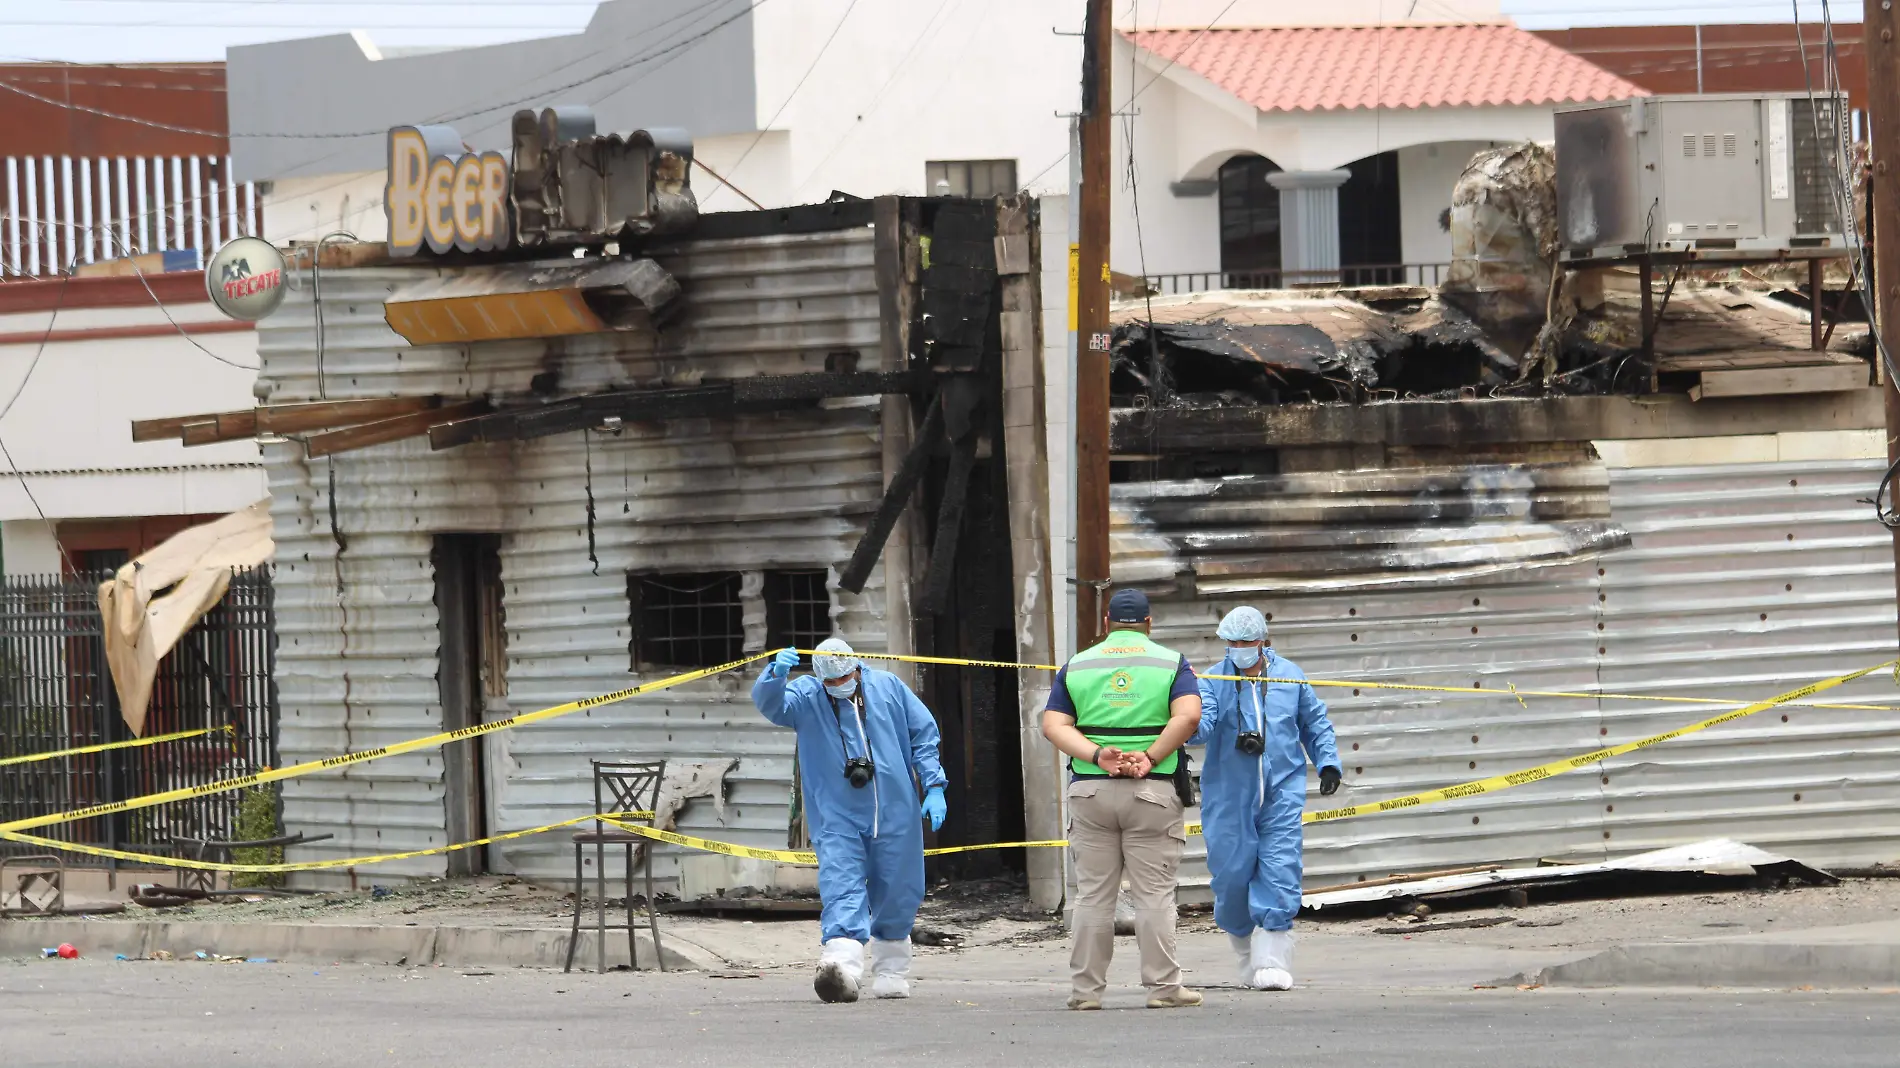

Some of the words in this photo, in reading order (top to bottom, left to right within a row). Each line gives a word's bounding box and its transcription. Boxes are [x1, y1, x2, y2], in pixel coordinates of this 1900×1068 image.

[387, 129, 509, 249] BEER
[223, 268, 281, 300] TECATE
[1101, 646, 1147, 655] SONORA
[192, 775, 258, 794] PRECAUCION
[322, 748, 387, 767] PRECAUCION
[450, 718, 515, 739] PRECAUCION
[577, 686, 641, 708] PRECAUCION
[1440, 783, 1485, 799] PRECAUCION
[1379, 797, 1420, 811] PRECAUCION
[1315, 807, 1356, 820] PRECAUCION
